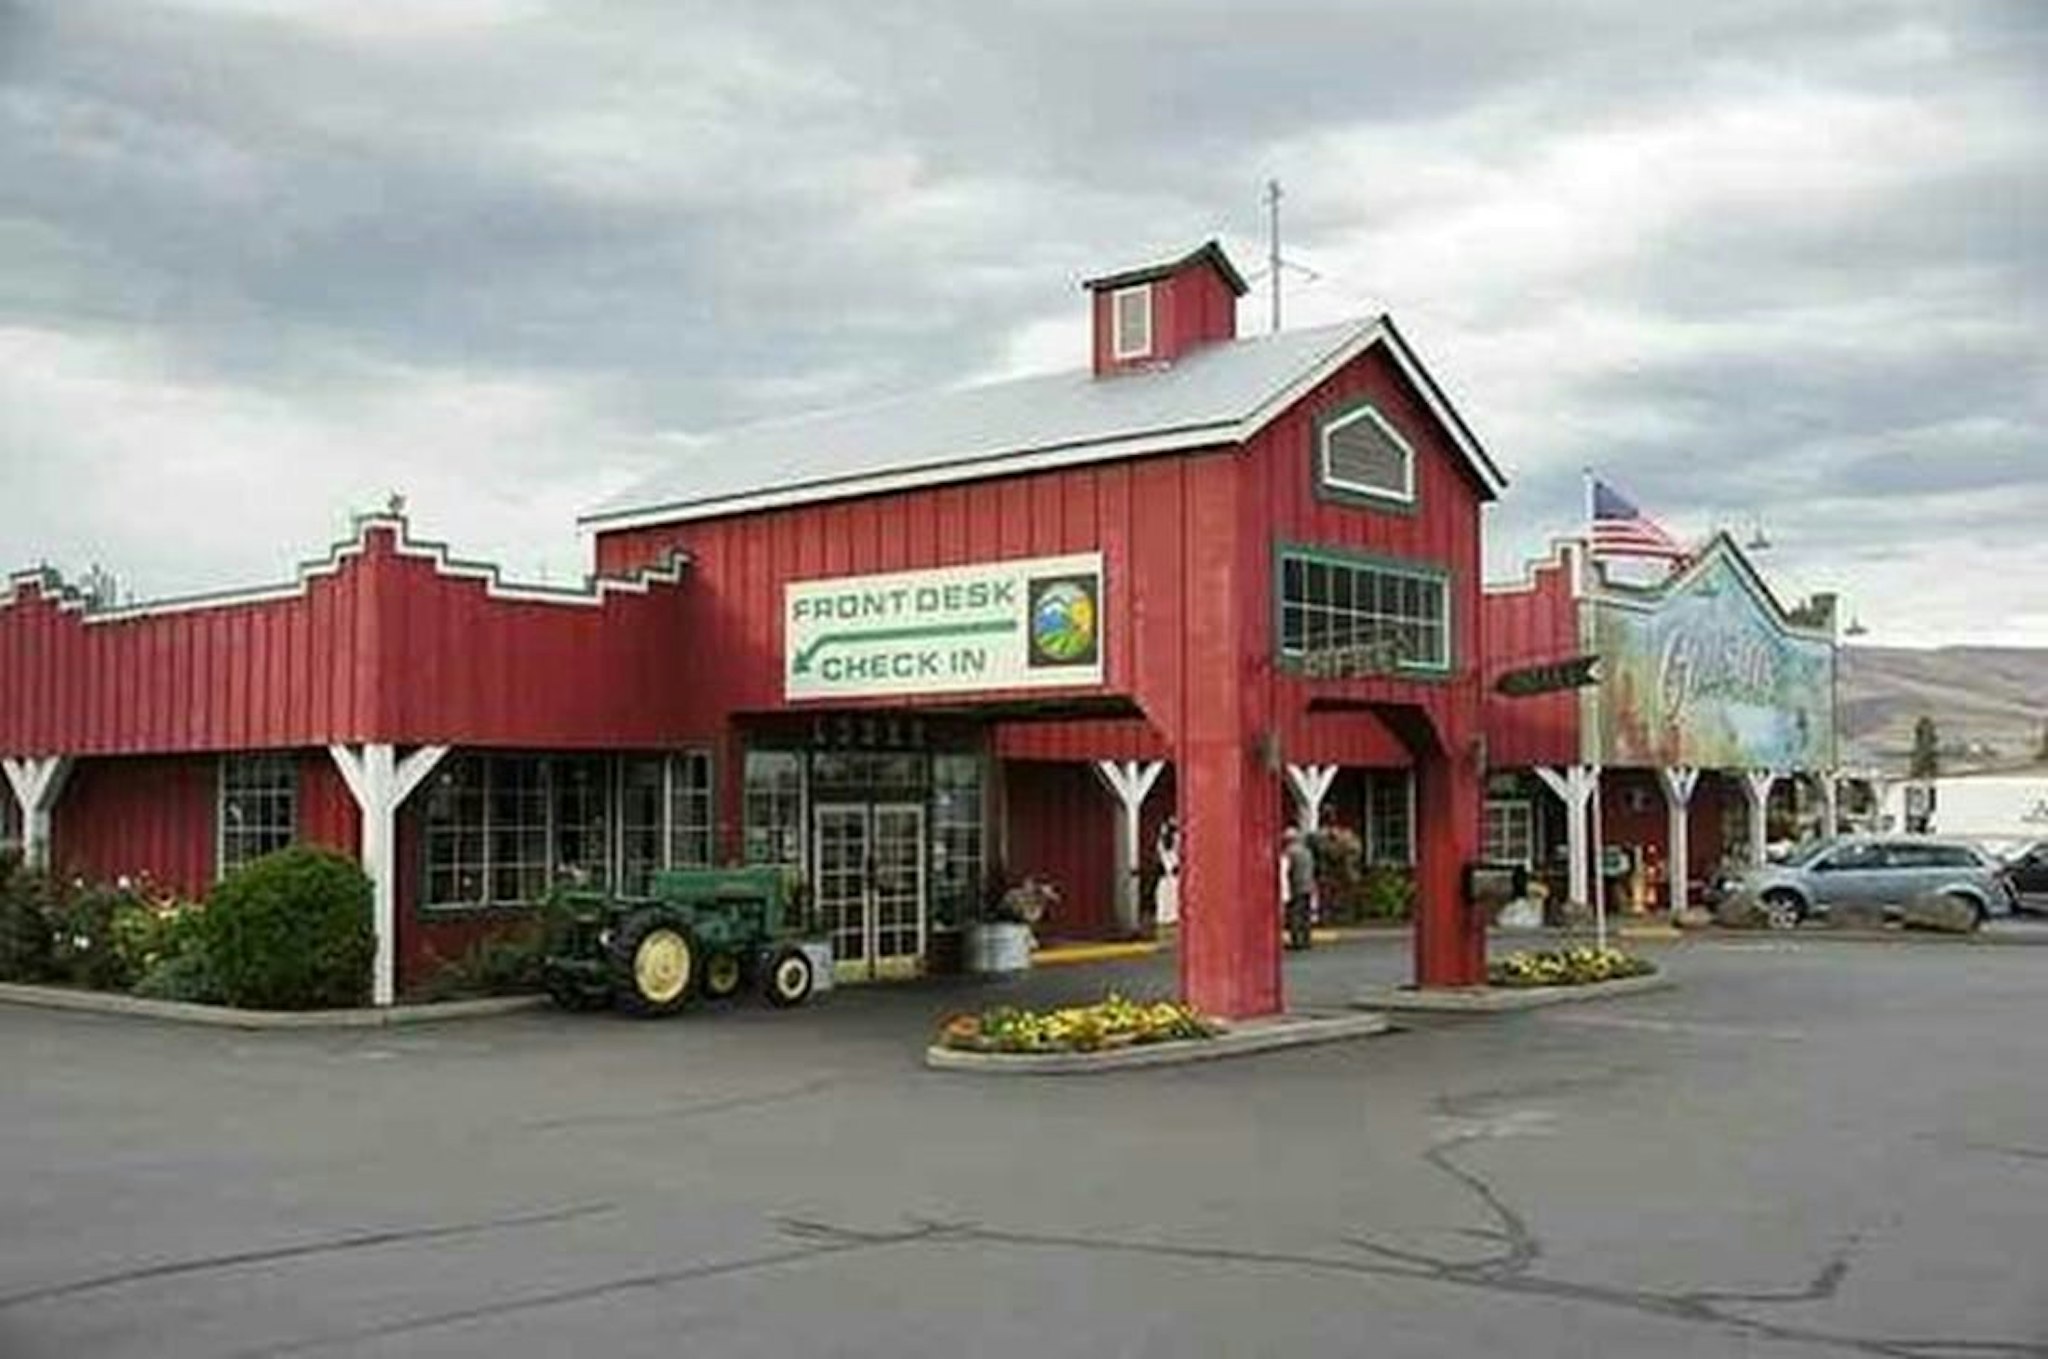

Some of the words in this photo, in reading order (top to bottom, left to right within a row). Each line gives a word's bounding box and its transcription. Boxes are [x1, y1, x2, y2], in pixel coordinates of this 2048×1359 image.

[793, 589, 910, 622] FRONT
[915, 580, 1016, 613] DESK
[821, 651, 939, 682] CHECK
[950, 648, 987, 674] IN
